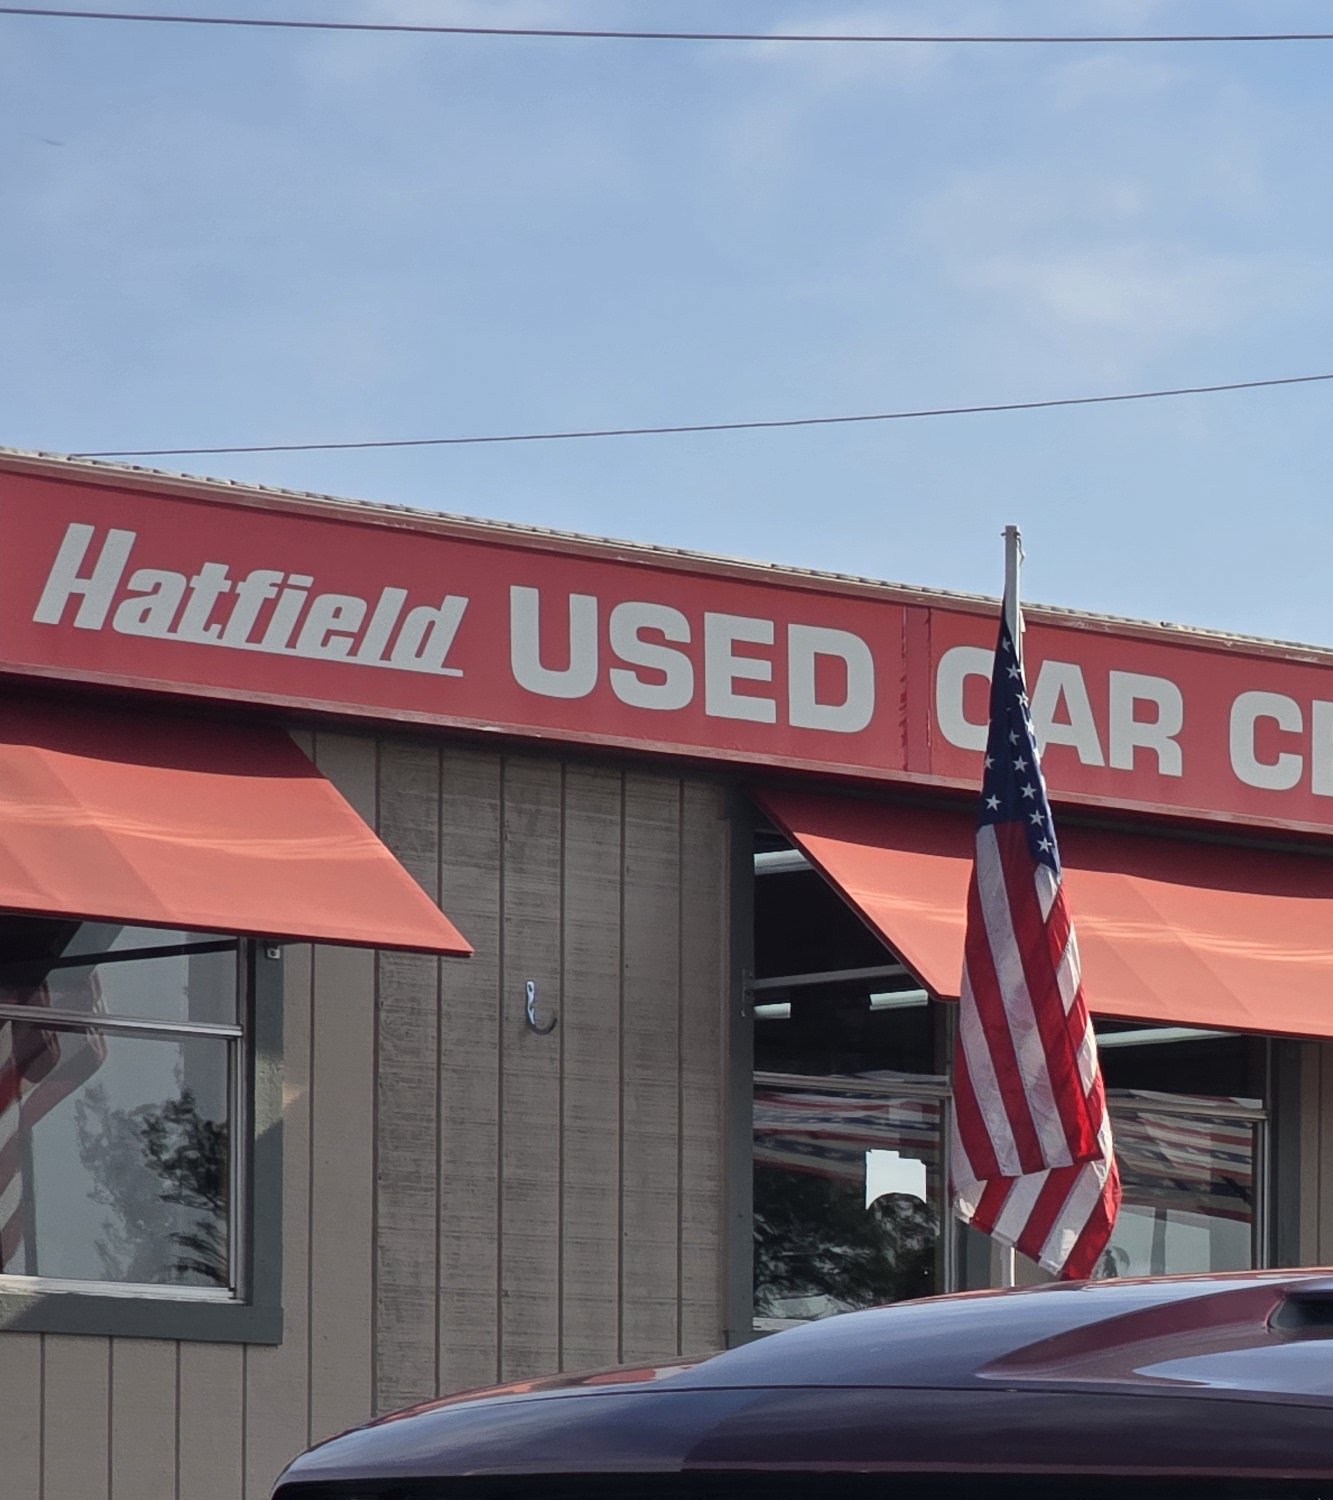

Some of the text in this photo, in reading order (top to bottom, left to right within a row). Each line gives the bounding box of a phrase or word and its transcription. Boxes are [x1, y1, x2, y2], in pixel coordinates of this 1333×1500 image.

[32, 522, 470, 678] Hatfield
[509, 585, 876, 734] USED
[936, 645, 1185, 778] CAR
